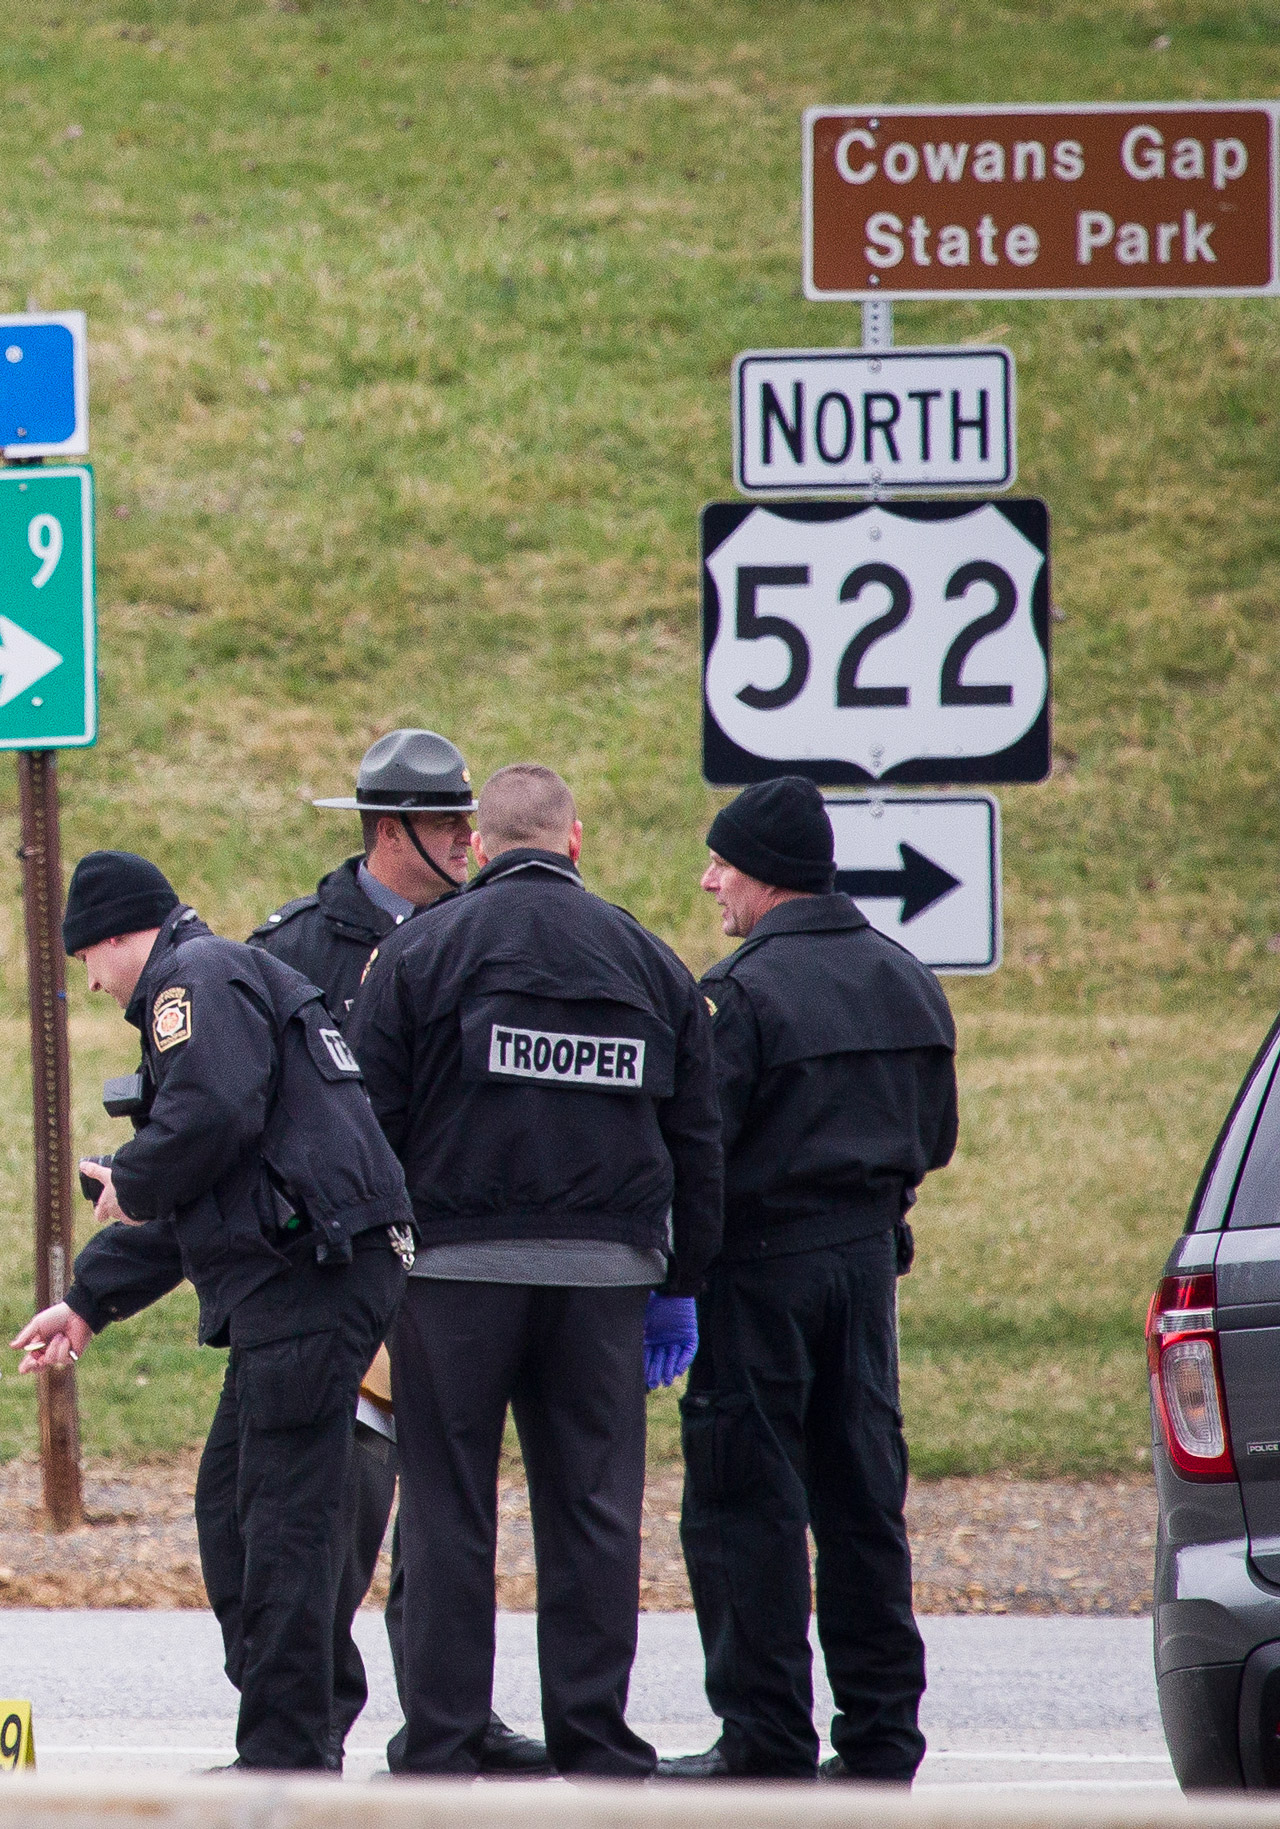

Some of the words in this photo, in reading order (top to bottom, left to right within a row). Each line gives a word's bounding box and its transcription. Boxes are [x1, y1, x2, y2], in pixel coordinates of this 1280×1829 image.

[836, 130, 1084, 184] Cowans
[1122, 126, 1247, 188] Gap
[865, 213, 1039, 268] State
[1078, 211, 1216, 264] Park
[761, 381, 989, 465] NORTH
[28, 514, 63, 588] 9
[735, 559, 1018, 711] 522
[496, 1030, 638, 1080] TROOPER
[1249, 1443, 1279, 1453] POLICE
